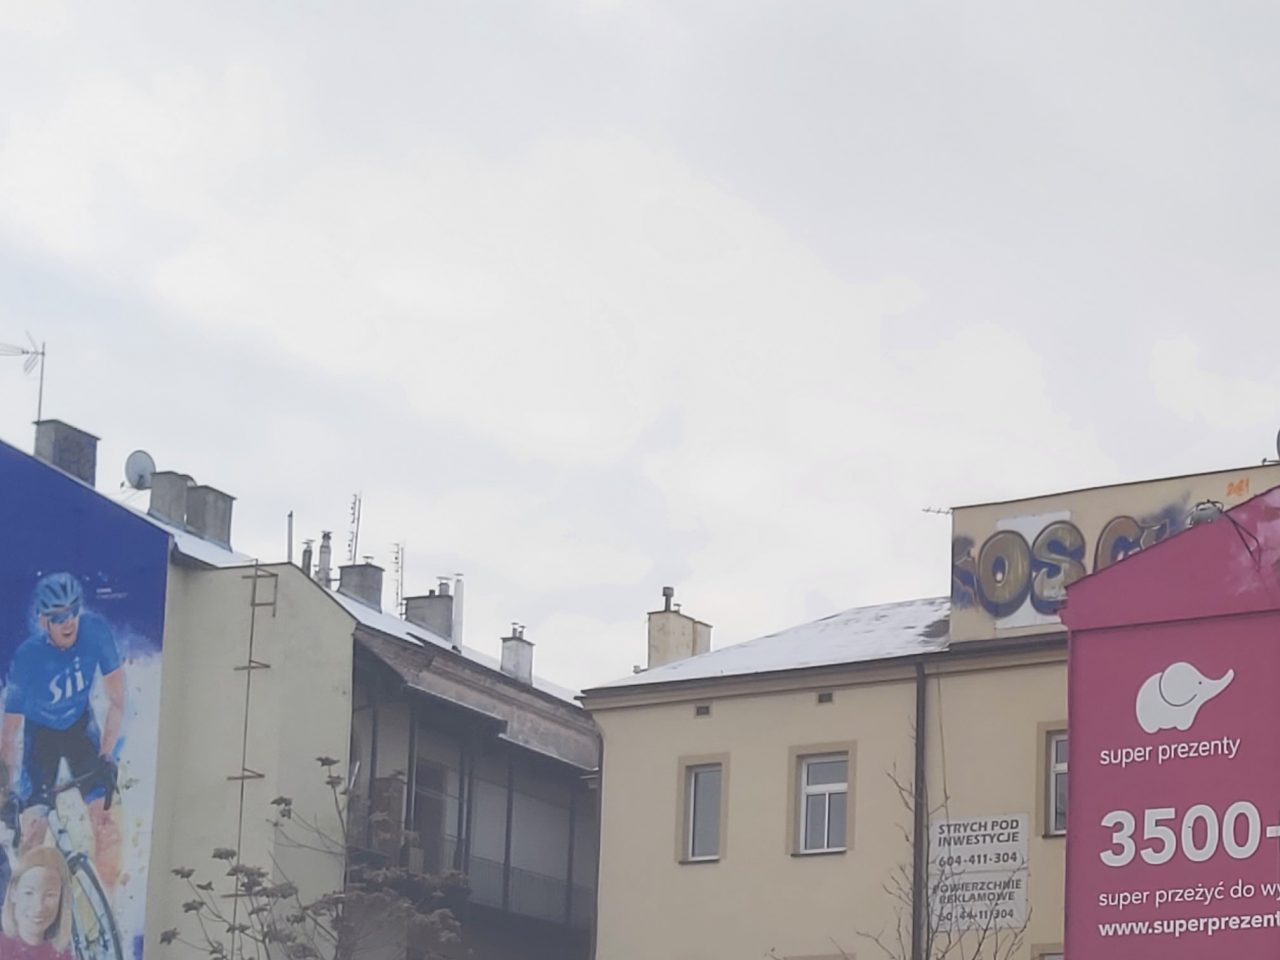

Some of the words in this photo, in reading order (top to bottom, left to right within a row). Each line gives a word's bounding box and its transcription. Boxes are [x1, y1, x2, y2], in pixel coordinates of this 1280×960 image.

[1100, 744, 1152, 768] super
[1158, 737, 1241, 764] prezenty
[938, 821, 987, 835] STRYCH
[991, 819, 1020, 831] POD
[938, 832, 1020, 847] INWESTYCJE
[939, 891, 1016, 905] REKLAMOWE
[1099, 890, 1149, 910] super
[1155, 880, 1225, 907] przeżyć
[1230, 879, 1255, 898] do
